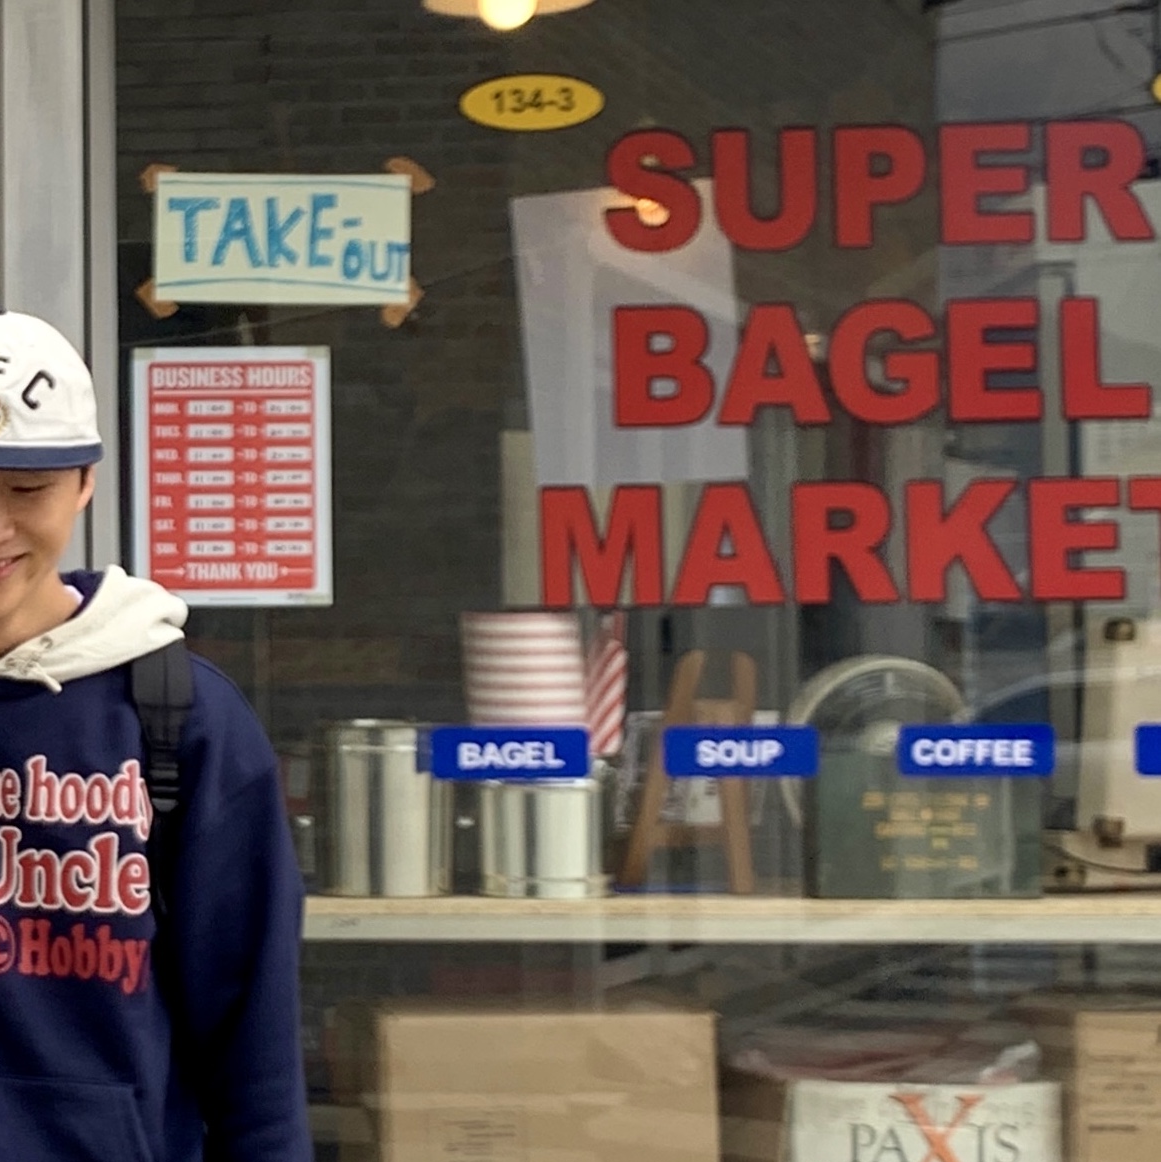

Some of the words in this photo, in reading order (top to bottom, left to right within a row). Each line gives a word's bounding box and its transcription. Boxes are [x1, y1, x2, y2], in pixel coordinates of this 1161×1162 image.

[492, 87, 576, 114] 134-3
[604, 119, 1156, 254] SUPER
[152, 366, 243, 388] BUSINESS
[247, 366, 312, 388] HOURS
[612, 299, 1152, 429] BAGEL
[187, 562, 242, 580] THANK
[246, 562, 278, 580] YOU
[457, 741, 567, 770] BAGEL
[695, 739, 786, 768] SOUP
[911, 738, 1036, 767] COFFEE
